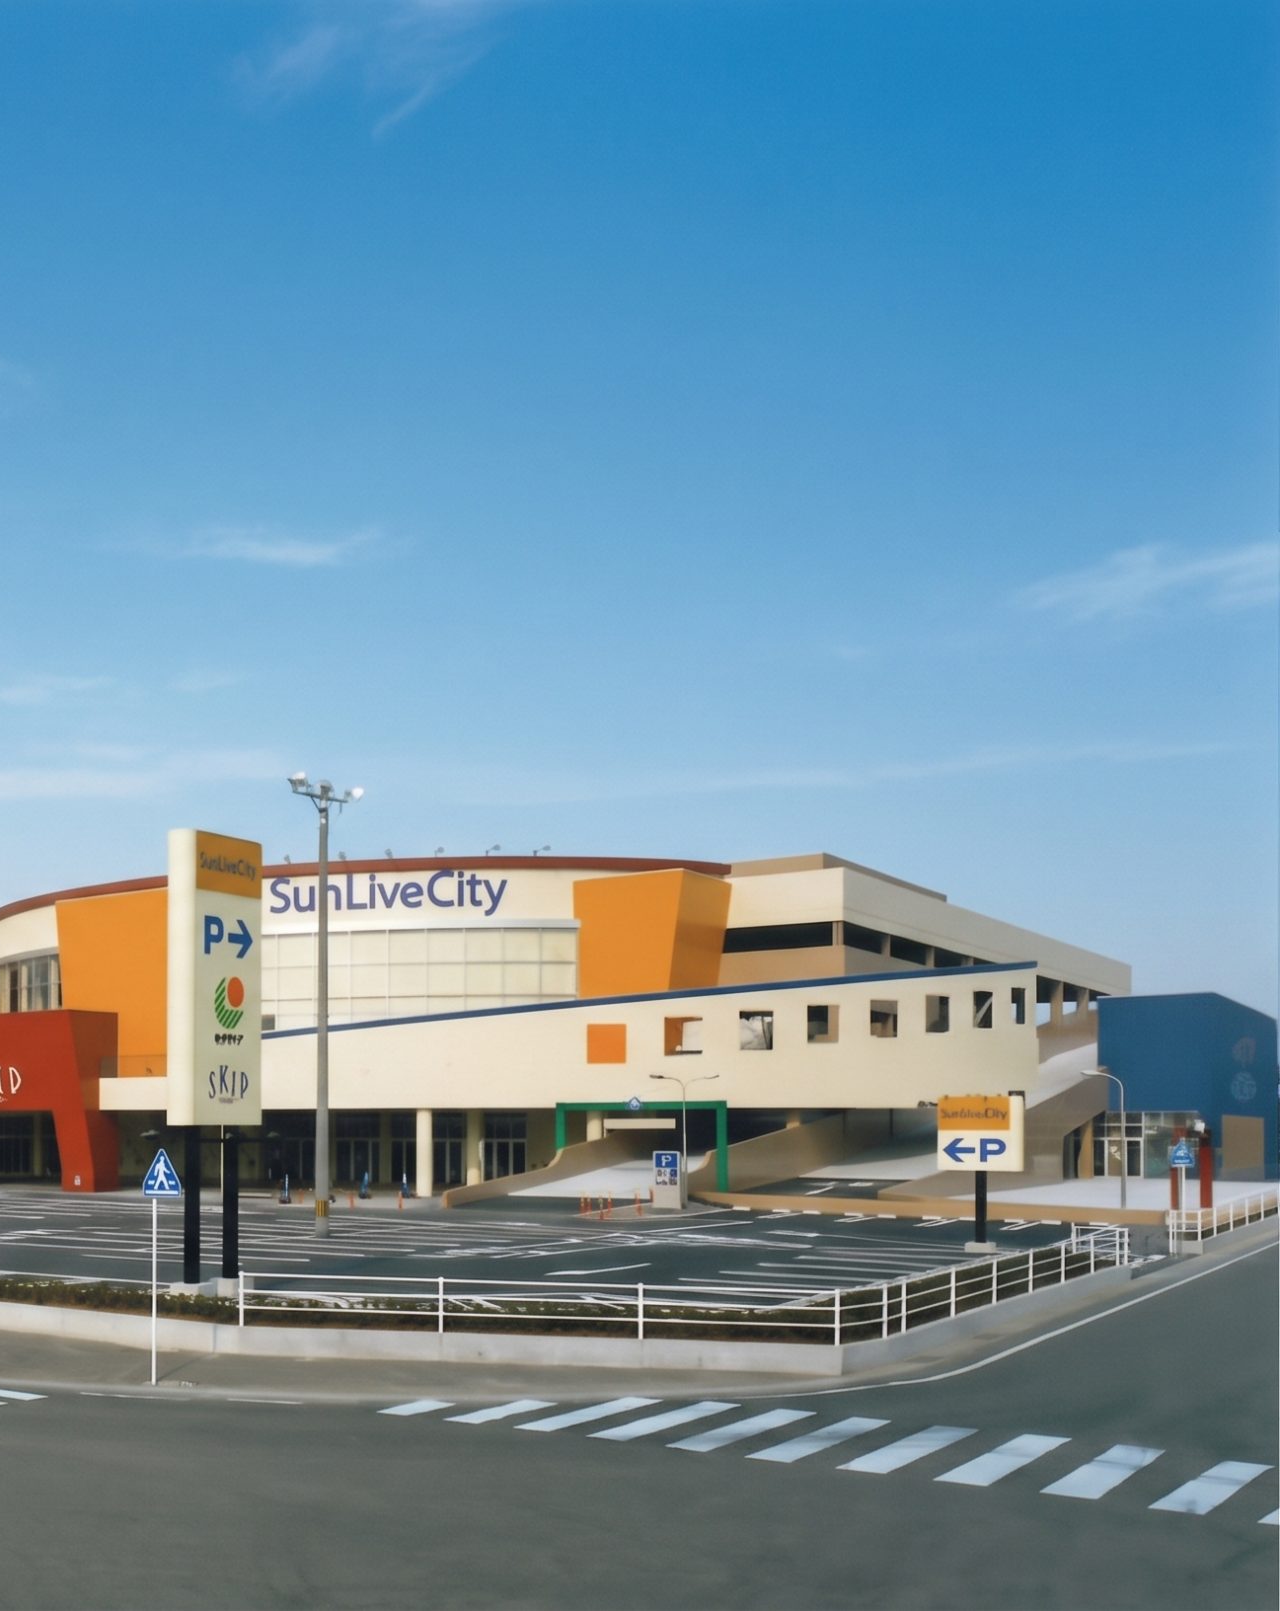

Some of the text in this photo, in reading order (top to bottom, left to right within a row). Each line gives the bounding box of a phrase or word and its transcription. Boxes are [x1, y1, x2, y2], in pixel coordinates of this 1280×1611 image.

[270, 868, 508, 917] SunLiveCity
[204, 915, 224, 954] P
[661, 1155, 672, 1167] P
[980, 1138, 1006, 1162] P
